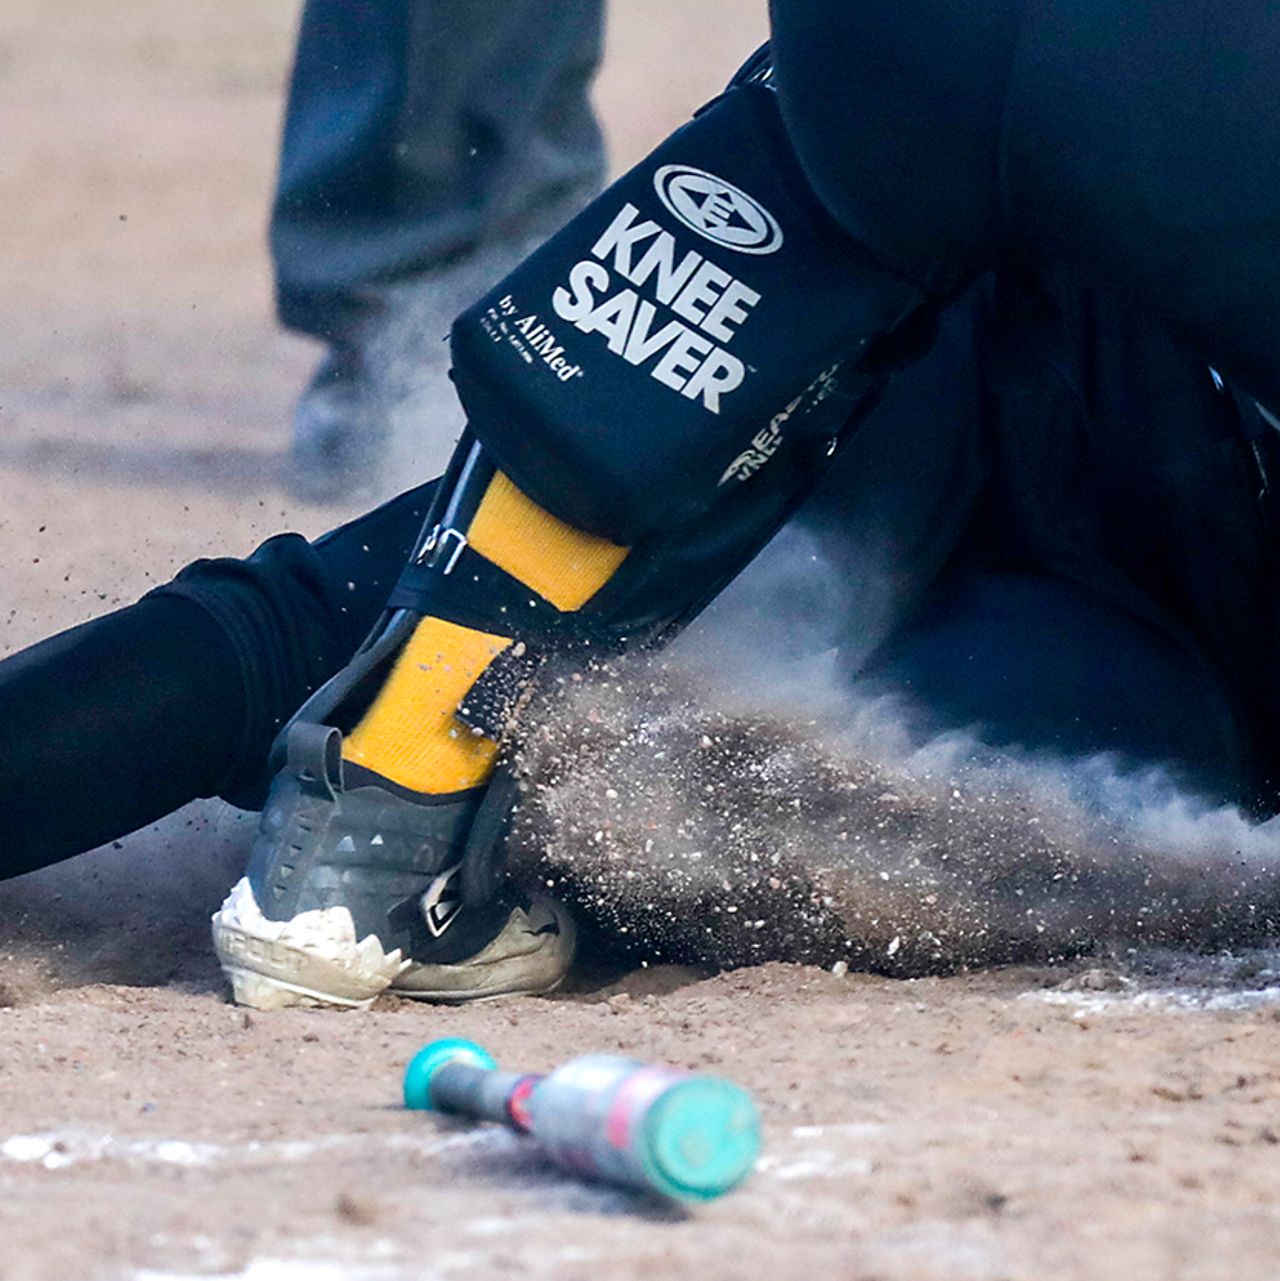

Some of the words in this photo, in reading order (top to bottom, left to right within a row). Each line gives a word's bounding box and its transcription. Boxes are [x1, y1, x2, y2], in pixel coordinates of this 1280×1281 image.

[499, 295, 519, 316] by
[552, 260, 746, 414] SAVER
[591, 203, 762, 342] KNEE
